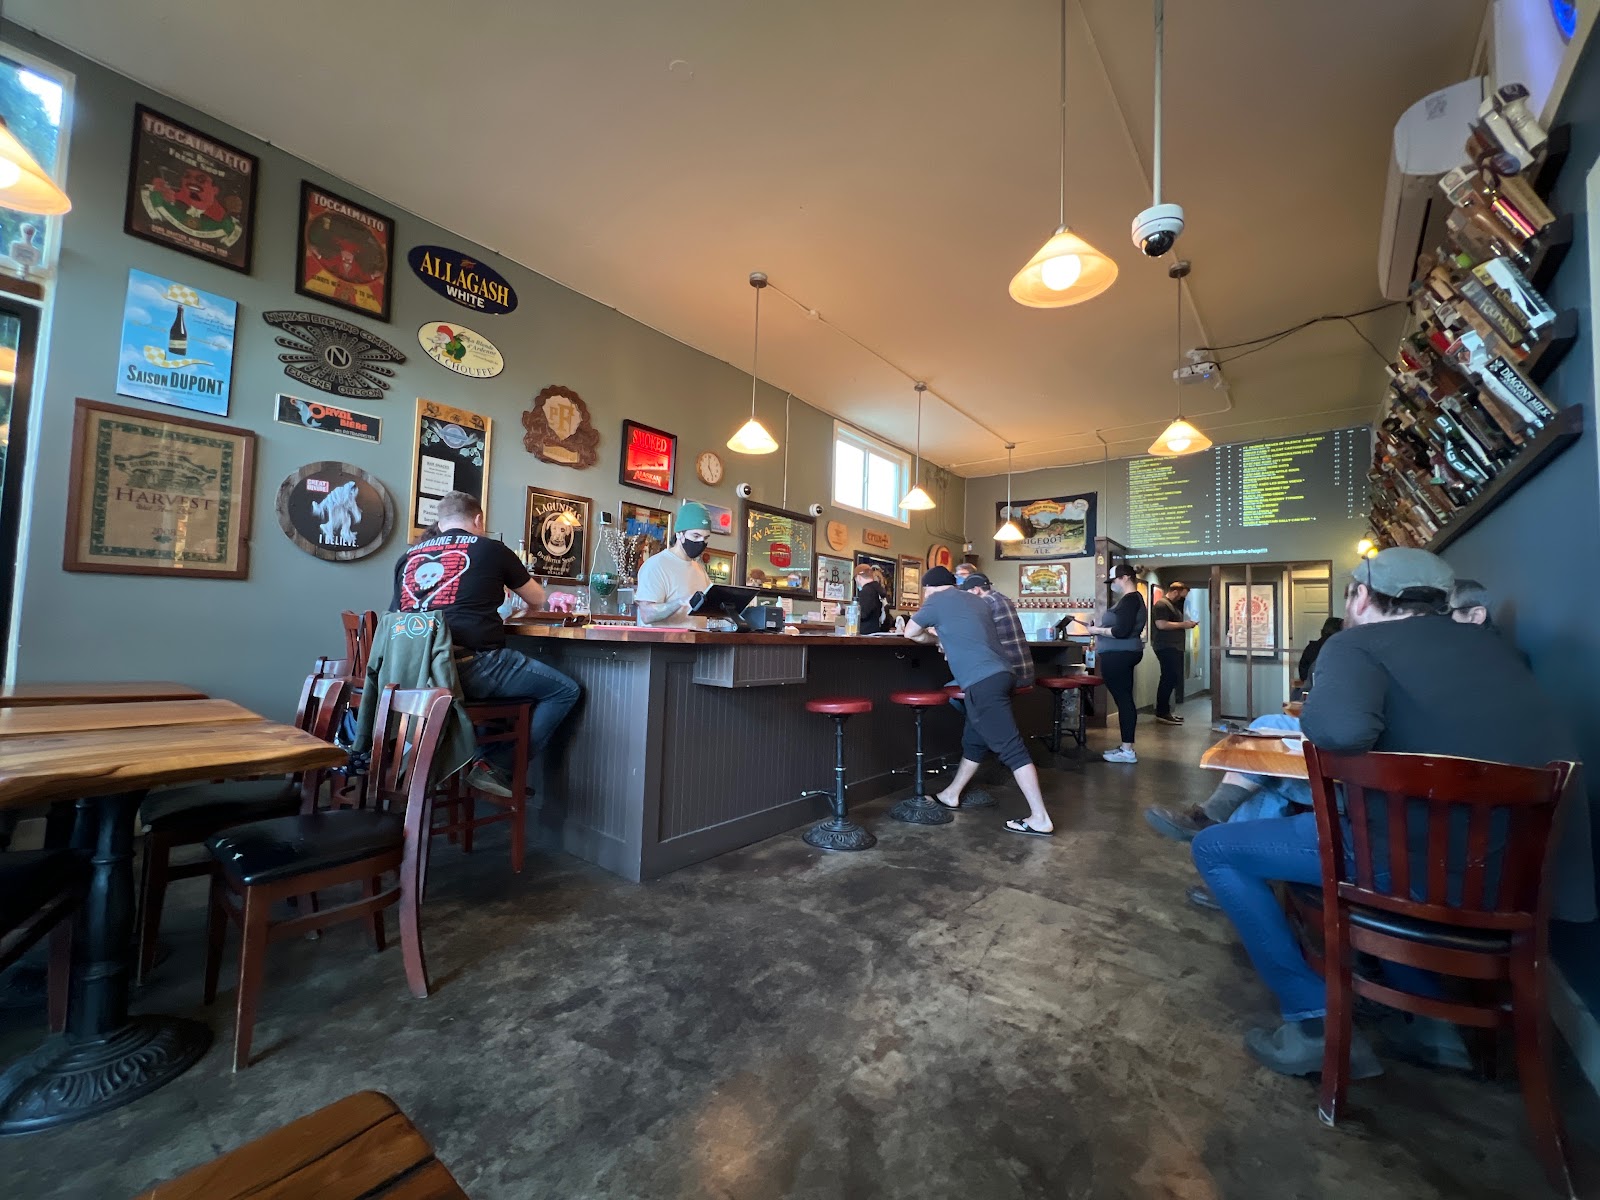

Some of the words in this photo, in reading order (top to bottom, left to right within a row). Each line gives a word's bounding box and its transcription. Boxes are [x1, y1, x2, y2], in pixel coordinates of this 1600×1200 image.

[144, 116, 250, 174] TOCCALMATTO
[313, 193, 384, 232] TOCCALMATTO
[420, 251, 510, 307] ALLAGASH
[446, 285, 485, 308] WHITE
[265, 312, 310, 323] NINKASI
[311, 314, 360, 335] BREWING
[360, 328, 405, 361] COMPANY
[330, 346, 347, 366] N
[428, 347, 441, 360] LA
[170, 372, 224, 396] DUPONT
[286, 365, 332, 391] EUGENE
[338, 385, 383, 399] OREGON
[1530, 397, 1551, 418] MILK
[632, 429, 668, 453] SMOKED
[115, 487, 214, 511] HARVEST
[536, 502, 582, 522] LAGUNITAS
[319, 534, 323, 544] I
[455, 535, 478, 545] TRIO
[1021, 536, 1062, 545] BIGFOOT
